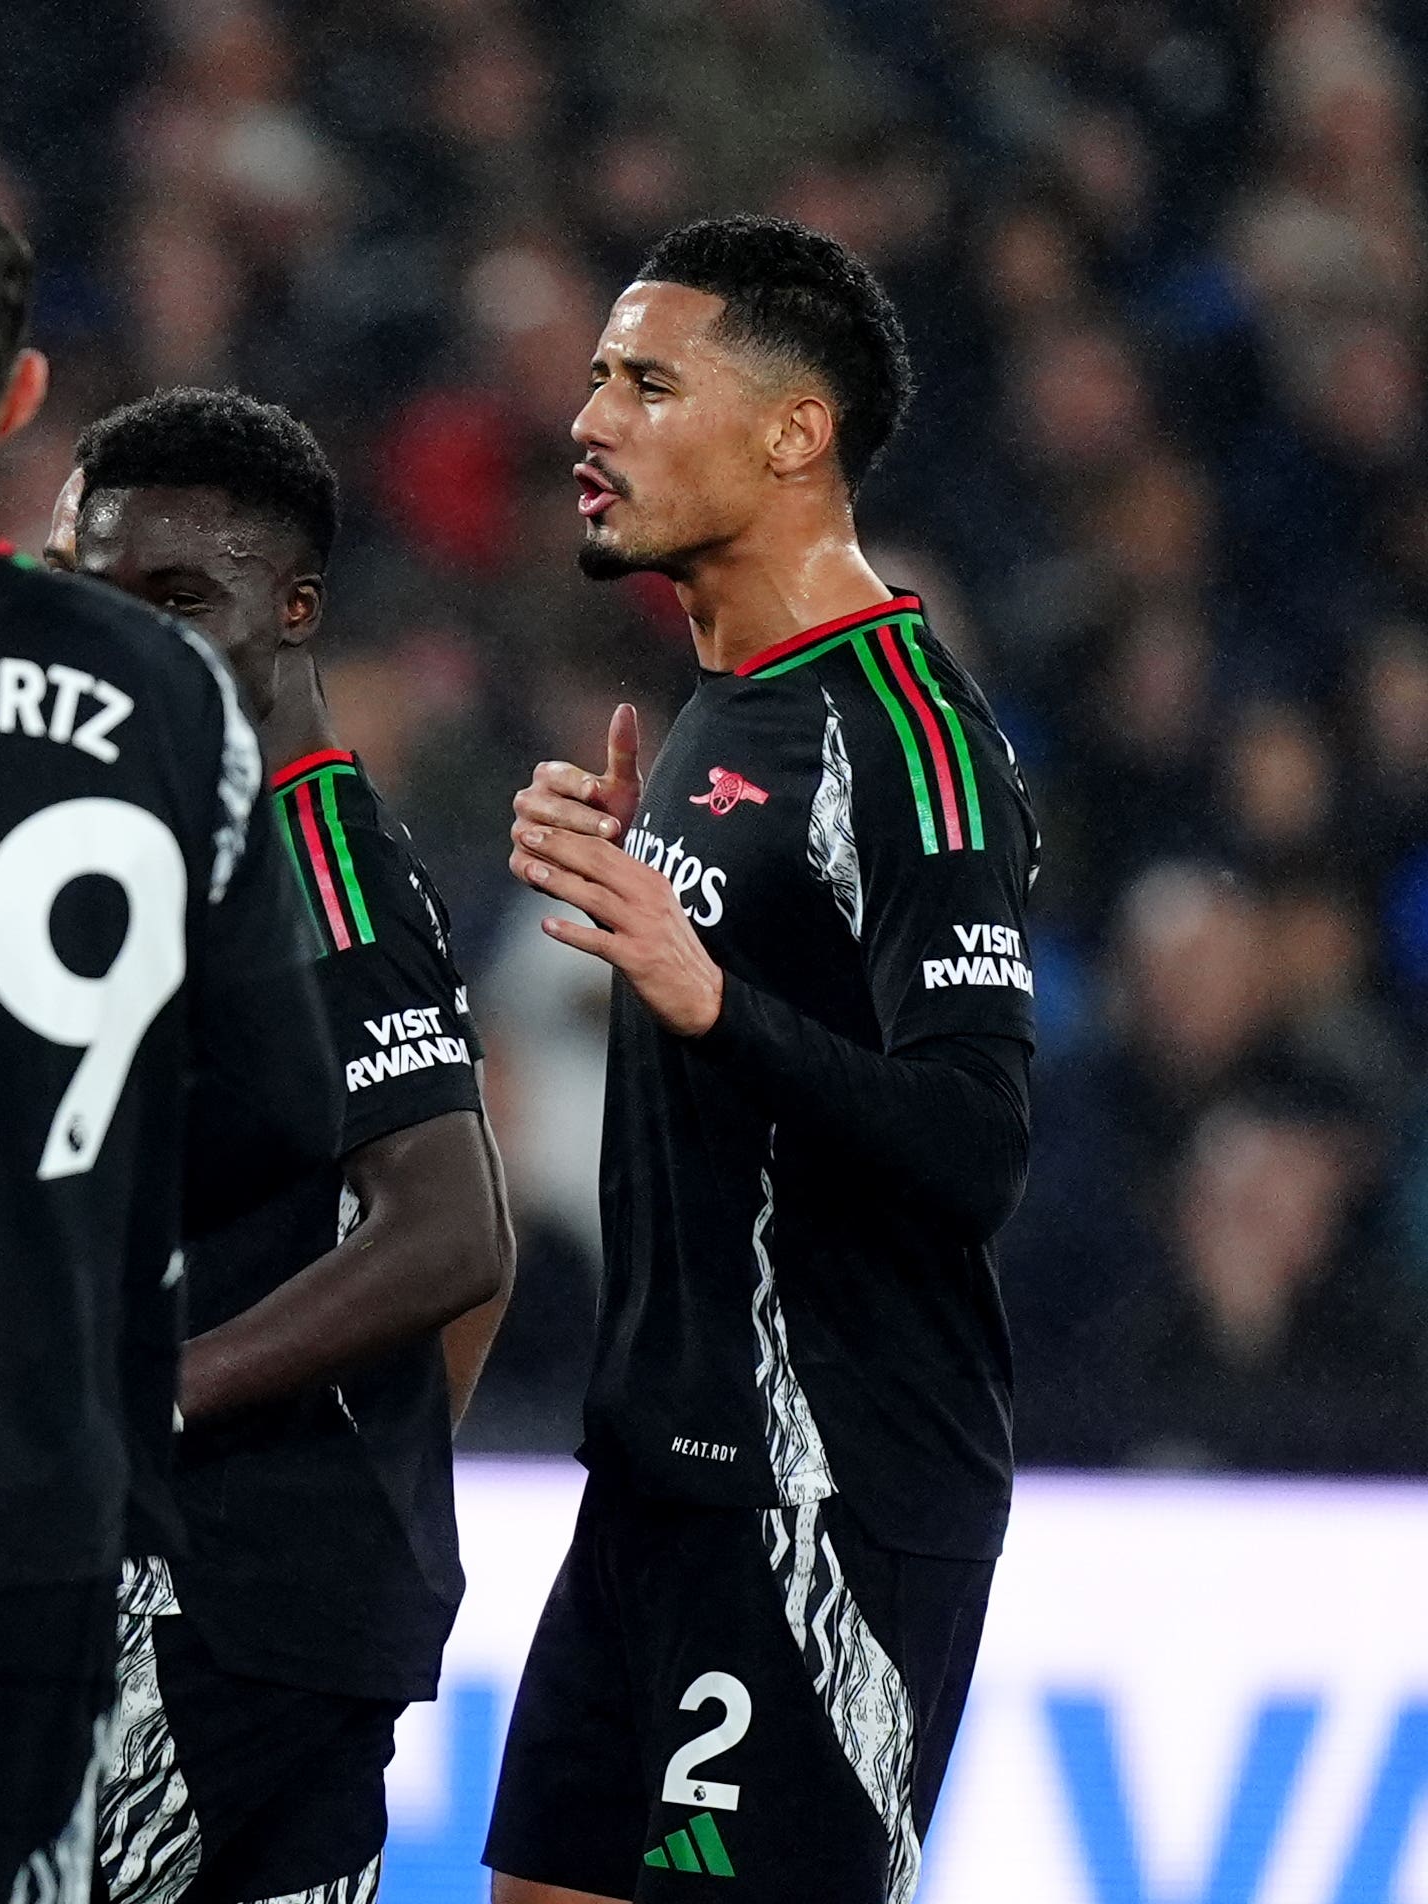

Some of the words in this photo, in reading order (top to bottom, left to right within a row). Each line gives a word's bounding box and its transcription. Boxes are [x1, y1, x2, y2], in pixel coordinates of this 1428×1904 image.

[952, 924, 1021, 958] VISIT
[364, 1007, 443, 1046] VISIT
[671, 1436, 737, 1462] HEAT.RDY
[661, 1671, 752, 1811] 2
